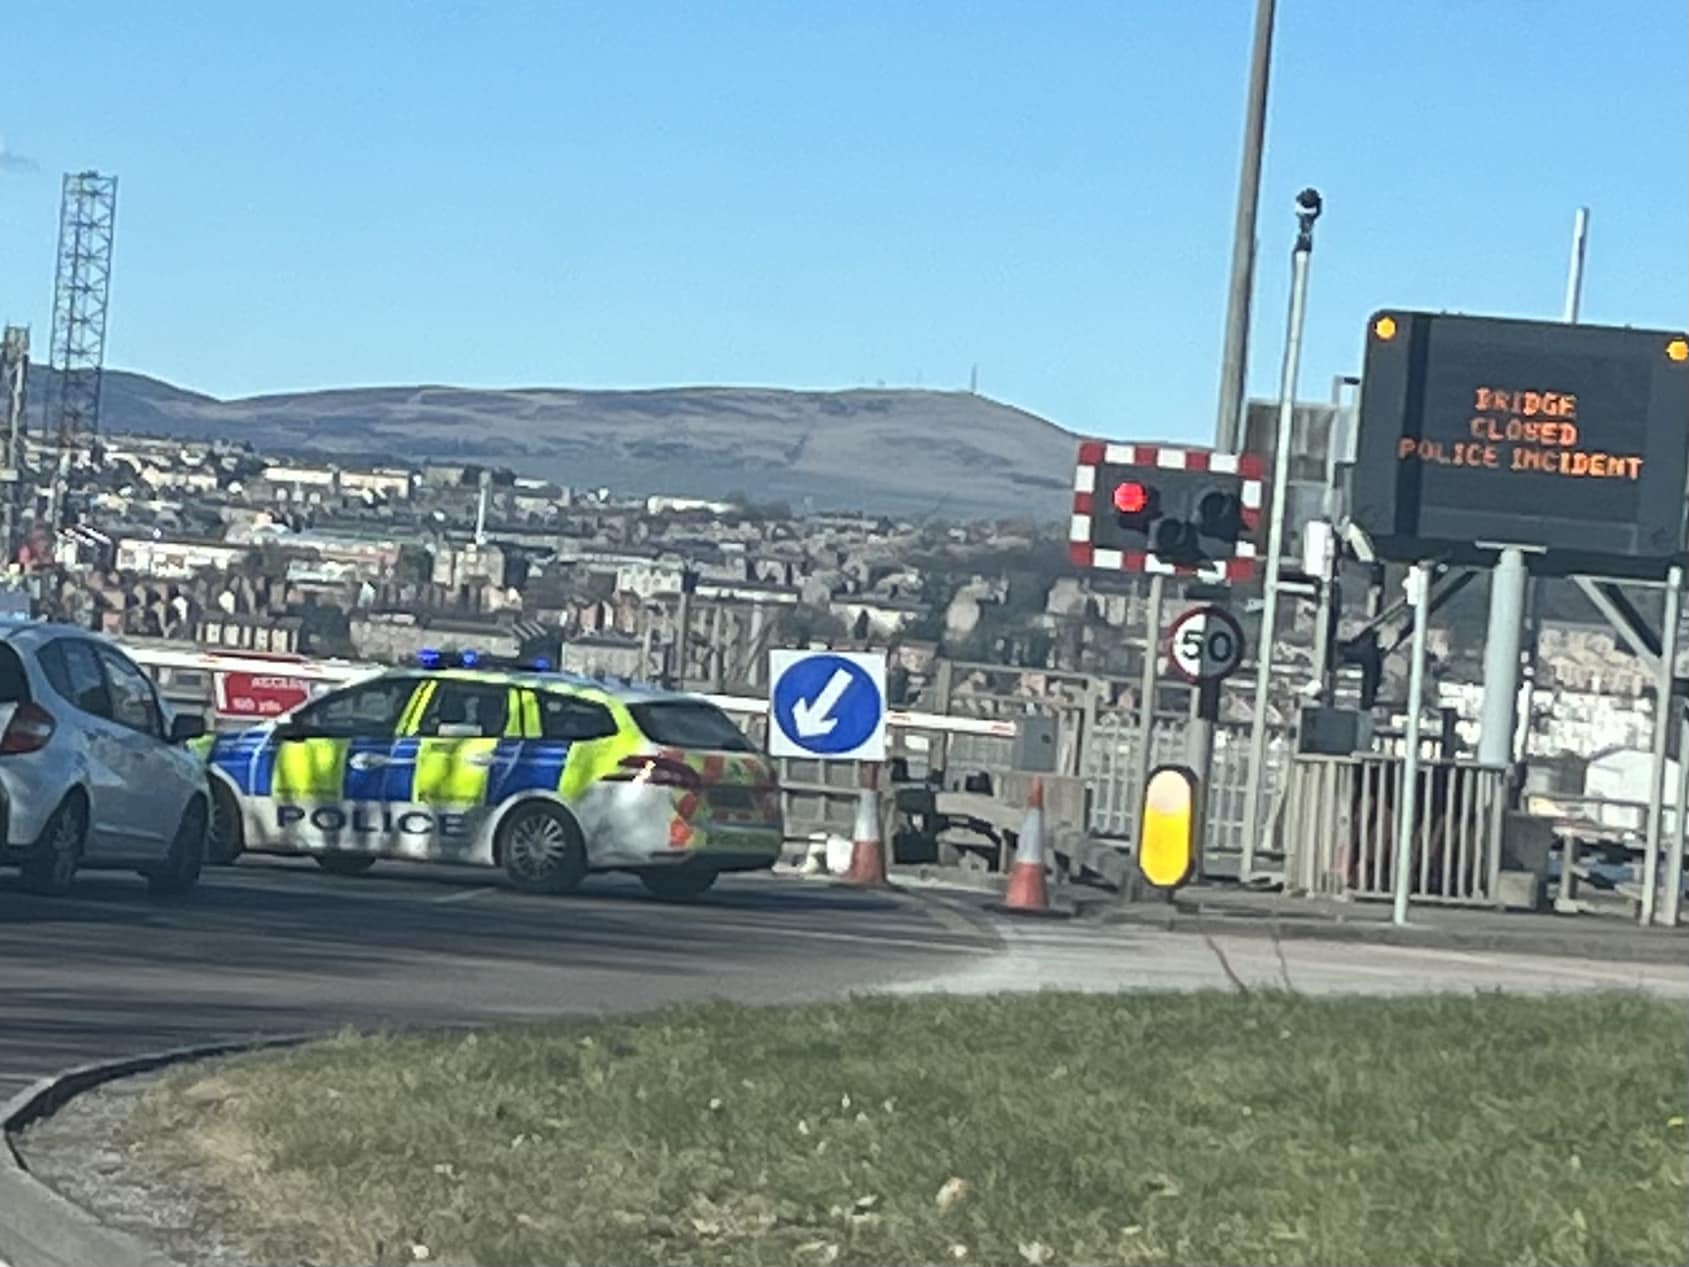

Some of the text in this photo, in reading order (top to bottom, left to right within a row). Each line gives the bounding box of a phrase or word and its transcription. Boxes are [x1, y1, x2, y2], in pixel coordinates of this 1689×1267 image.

[1475, 387, 1577, 417] BRIDGE
[1470, 417, 1577, 446] CLOSED
[1399, 438, 1643, 480] POLICE INCIDENT
[1183, 630, 1232, 662] 50
[276, 805, 466, 837] POLICE
